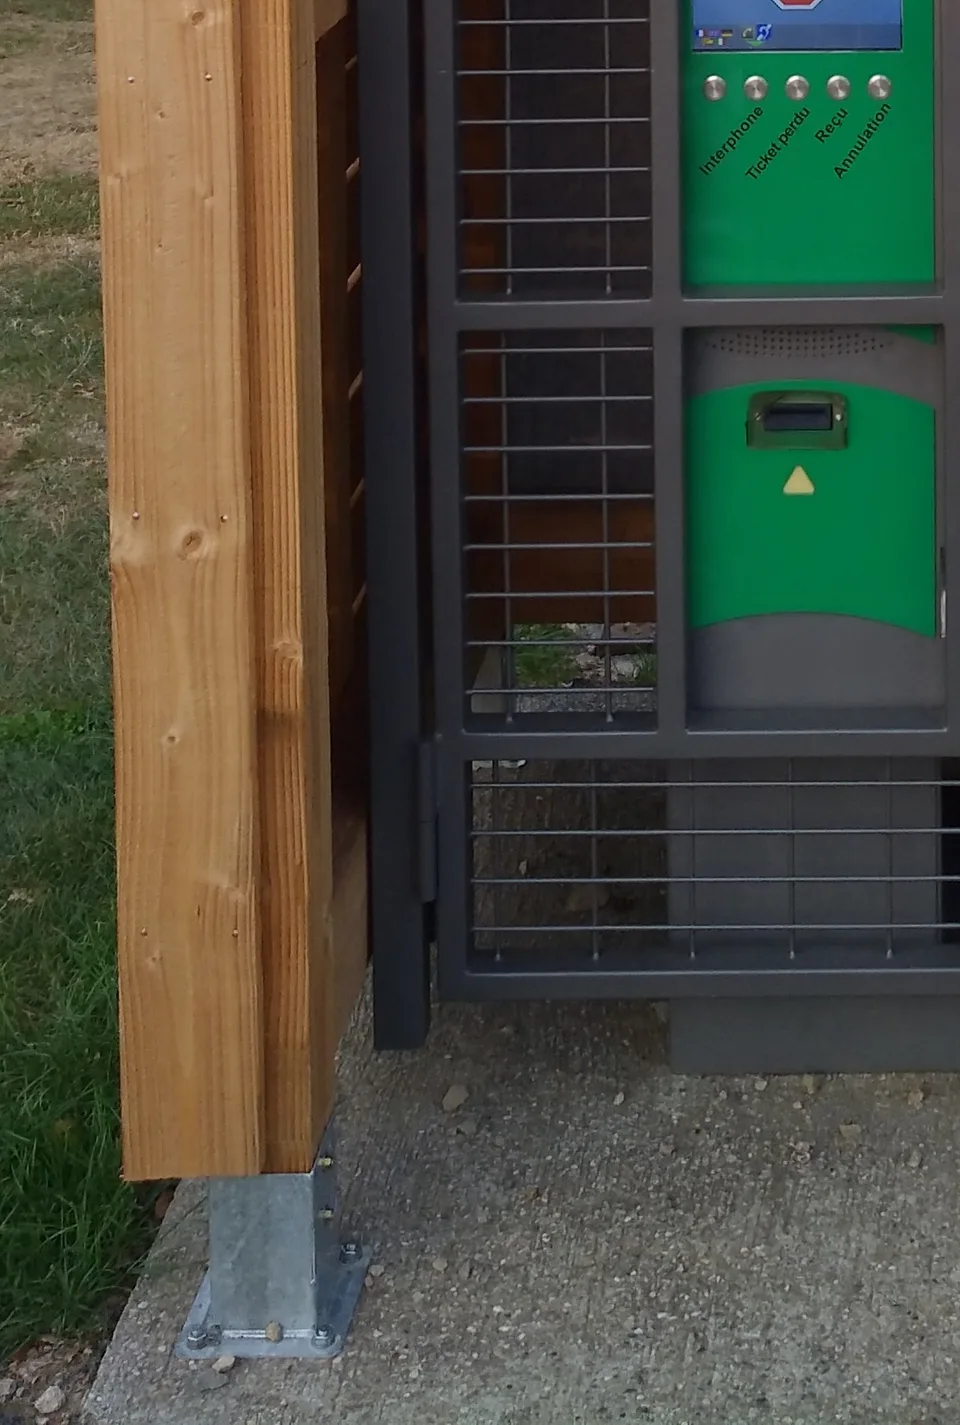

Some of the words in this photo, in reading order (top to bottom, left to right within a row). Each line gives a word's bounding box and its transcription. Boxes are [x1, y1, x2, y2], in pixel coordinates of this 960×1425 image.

[699, 105, 764, 176] Interphone
[745, 142, 782, 181] Ticket
[778, 106, 811, 147] perdu
[814, 107, 848, 144] Reçu
[833, 103, 892, 179] Annulation
